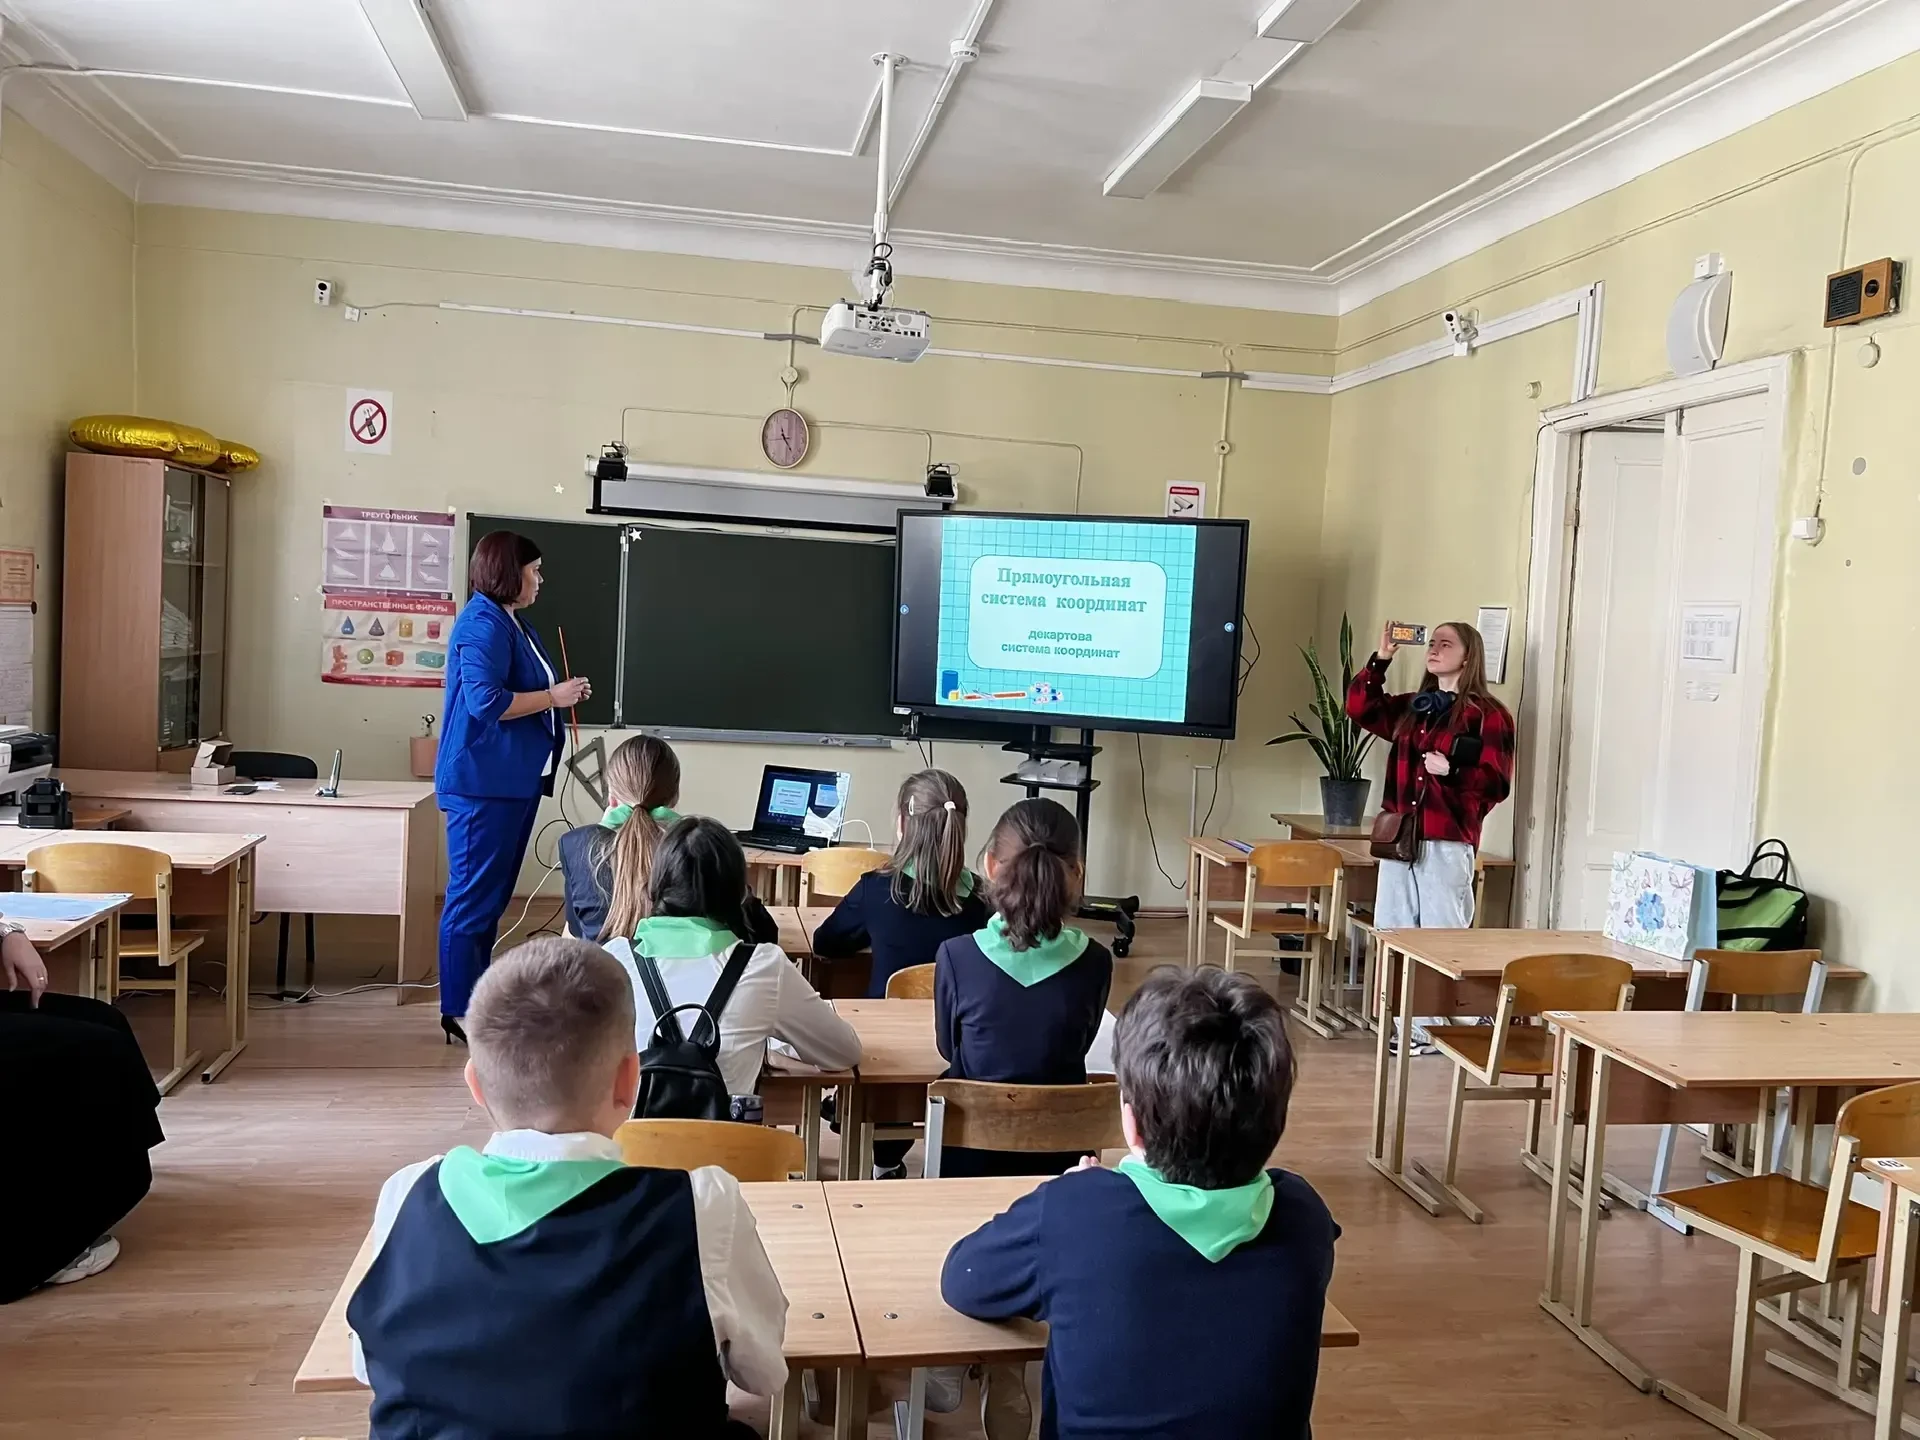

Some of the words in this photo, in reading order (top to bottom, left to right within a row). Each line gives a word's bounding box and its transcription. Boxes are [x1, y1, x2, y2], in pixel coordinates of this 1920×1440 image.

[361, 511, 419, 521] ТРЕУГОЛЬНИК
[997, 567, 1131, 588] Прямоугольная
[331, 599, 415, 611] ПРОСТРАНСТВЕННЫЕ
[415, 603, 448, 612] ФИГУРЫ
[981, 593, 1047, 608] система
[1056, 596, 1147, 613] координат
[1028, 630, 1092, 643] декартова
[1001, 643, 1051, 655] система
[1054, 645, 1121, 659] координат
